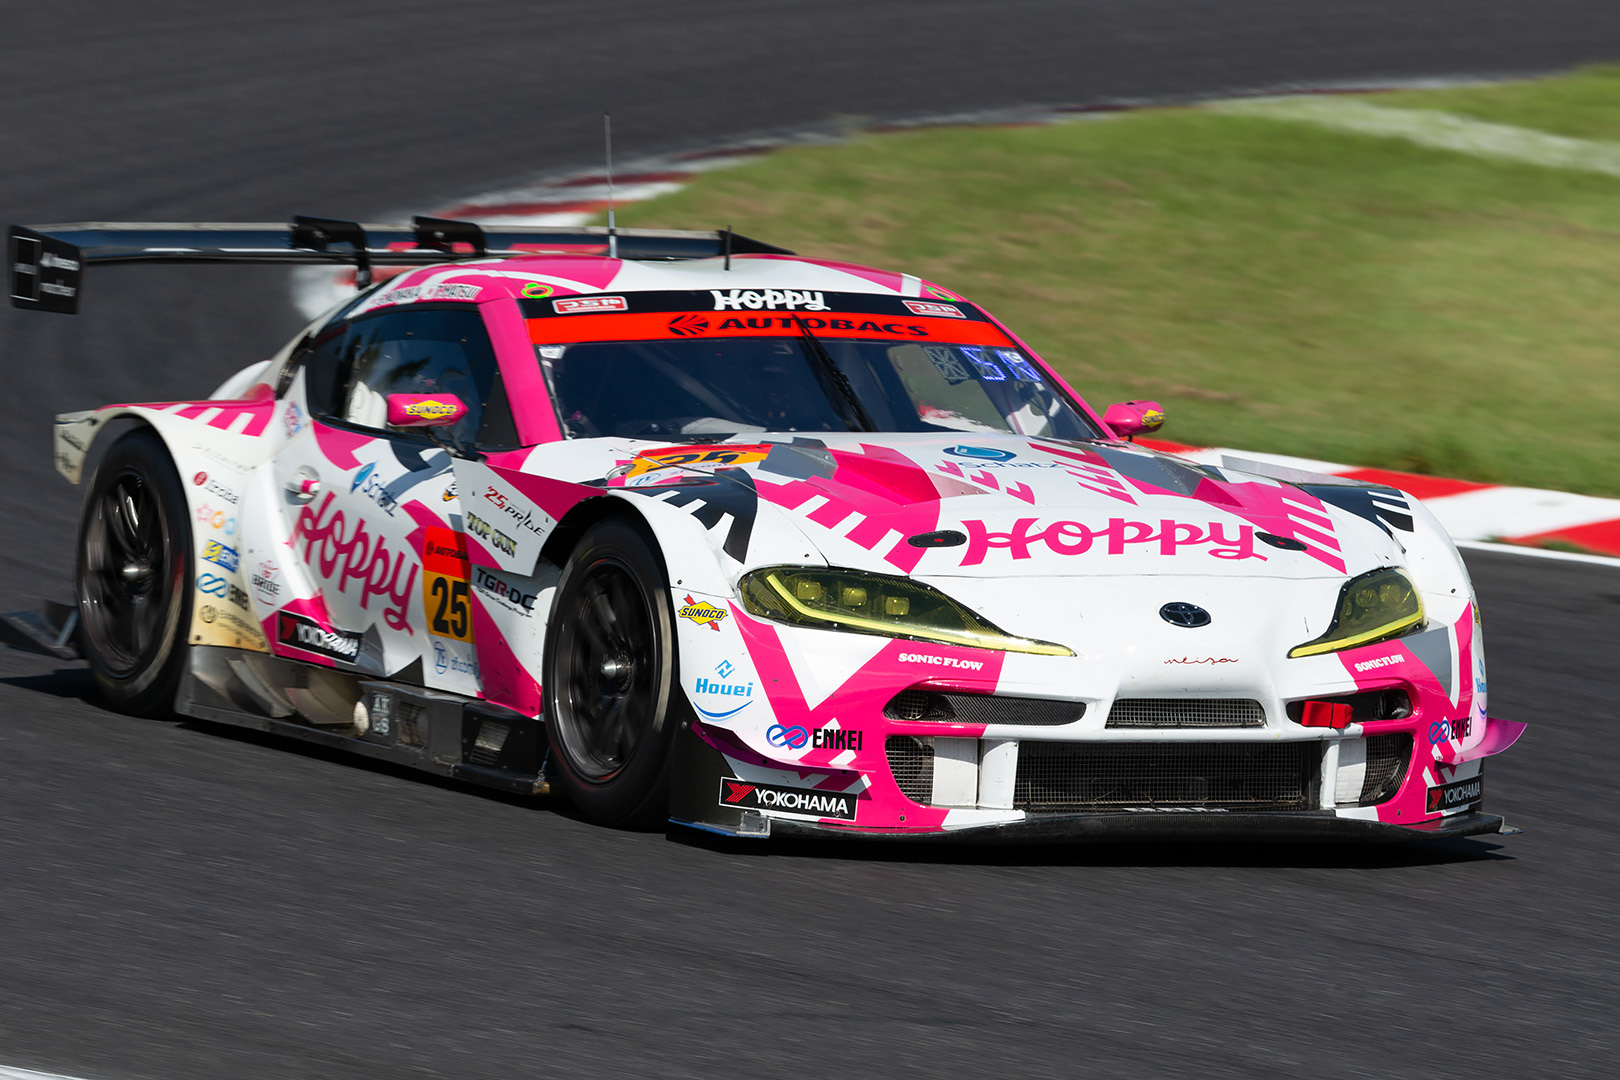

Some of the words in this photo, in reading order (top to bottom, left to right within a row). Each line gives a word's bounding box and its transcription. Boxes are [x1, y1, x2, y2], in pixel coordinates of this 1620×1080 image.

[710, 289, 831, 311] Hoppy
[718, 318, 929, 337] AUTOBACS
[958, 461, 1066, 469] Schatz
[504, 508, 546, 537] PRIDE
[467, 511, 492, 540] TOP
[492, 528, 518, 559] GUN
[958, 518, 1268, 567] Hoppy
[282, 490, 420, 637] Hoppy
[432, 577, 468, 638] 25
[680, 606, 726, 620] SUNOCO
[898, 652, 943, 666] SONIC
[943, 657, 984, 671] FLOW
[695, 678, 753, 697] Houei
[812, 728, 863, 750] ENKEI
[1451, 716, 1472, 740] ENKEI
[755, 789, 848, 814] YOKOHAMA
[1444, 781, 1481, 804] YOKOHAMA
